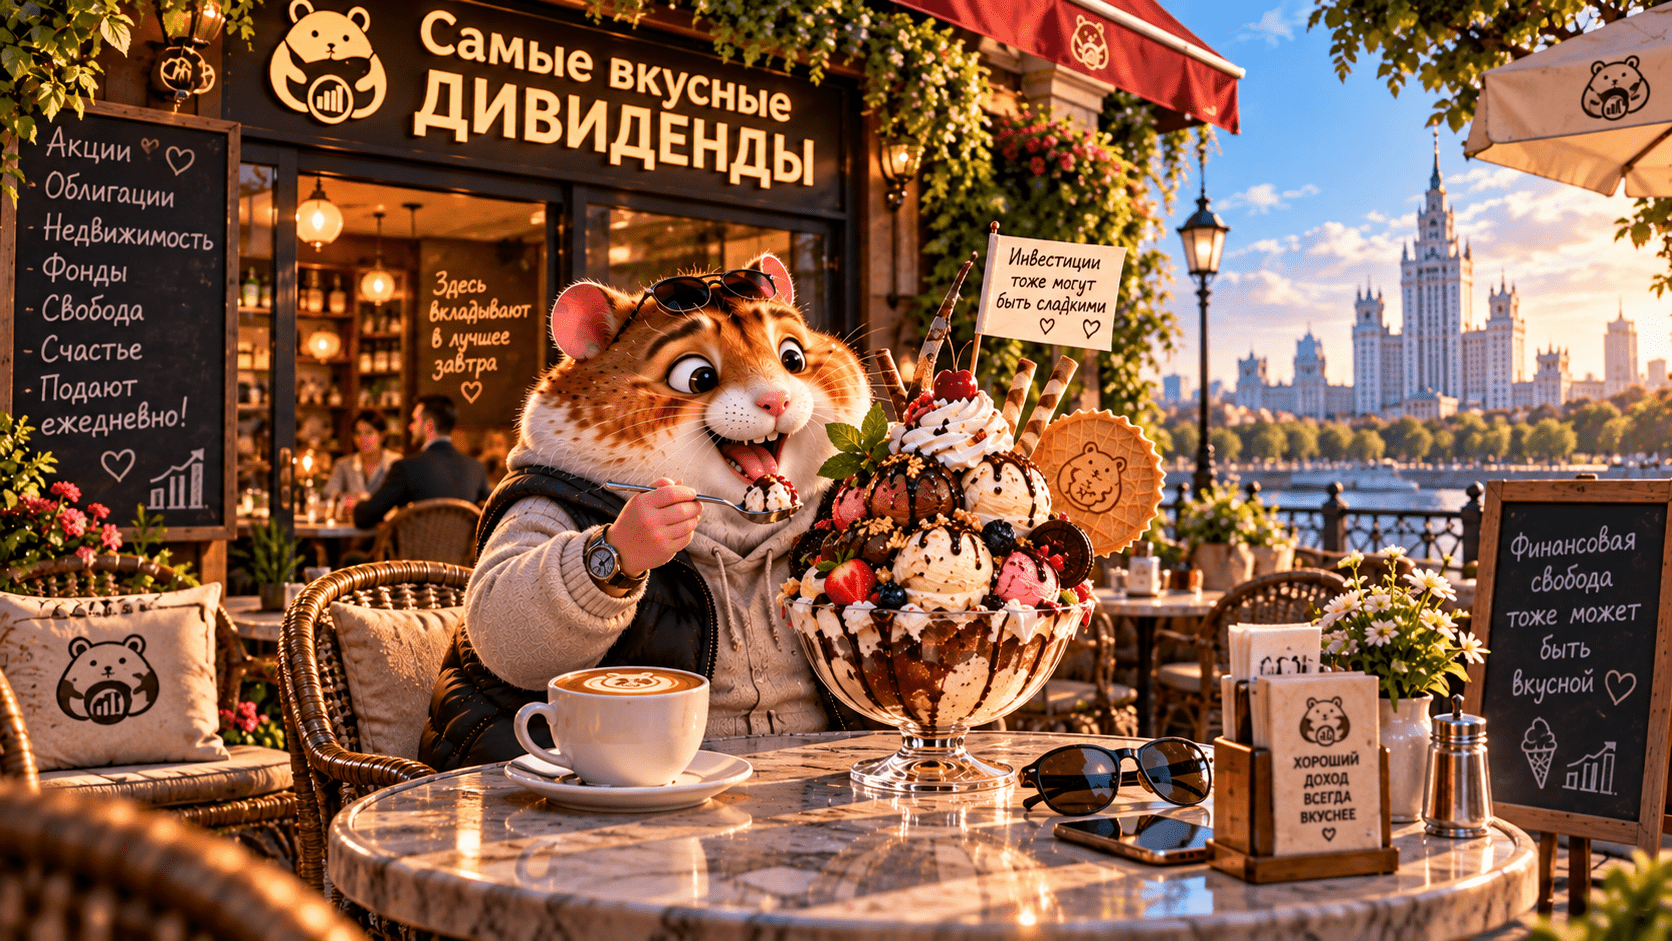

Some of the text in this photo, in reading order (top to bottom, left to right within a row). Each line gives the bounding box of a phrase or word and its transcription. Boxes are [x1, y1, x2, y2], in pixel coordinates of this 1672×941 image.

[419, 9, 792, 122] Самые вкусные
[413, 68, 815, 189] ДИВИДЕНДЫ
[46, 126, 131, 163] Акции
[45, 171, 174, 209] Облигации
[44, 213, 214, 251] Недвижимость
[42, 252, 127, 283] Фонды
[1008, 247, 1101, 272] Инвестиции
[433, 270, 487, 299] Здесь
[1011, 276, 1097, 297] тоже могут
[42, 294, 144, 327] Свобода
[429, 298, 532, 325] вкладывают
[996, 292, 1106, 315] быть сладкими
[41, 335, 143, 363] Счастье
[431, 327, 510, 353] в лучшее
[432, 352, 498, 381] завтра
[40, 374, 138, 405] Подают
[41, 396, 188, 438] ежедневно!
[1510, 525, 1636, 562] Финансовая
[1530, 564, 1613, 594] свобода
[1506, 603, 1642, 628] тоже может
[1539, 634, 1591, 660] быть
[1512, 668, 1594, 705] вкусной
[1293, 751, 1360, 769] ХОРОШИЙ
[1303, 772, 1349, 789] ДОХОД
[1304, 791, 1352, 806] ВСЕГДА
[1300, 808, 1356, 824] ВКУСНЕЕ
